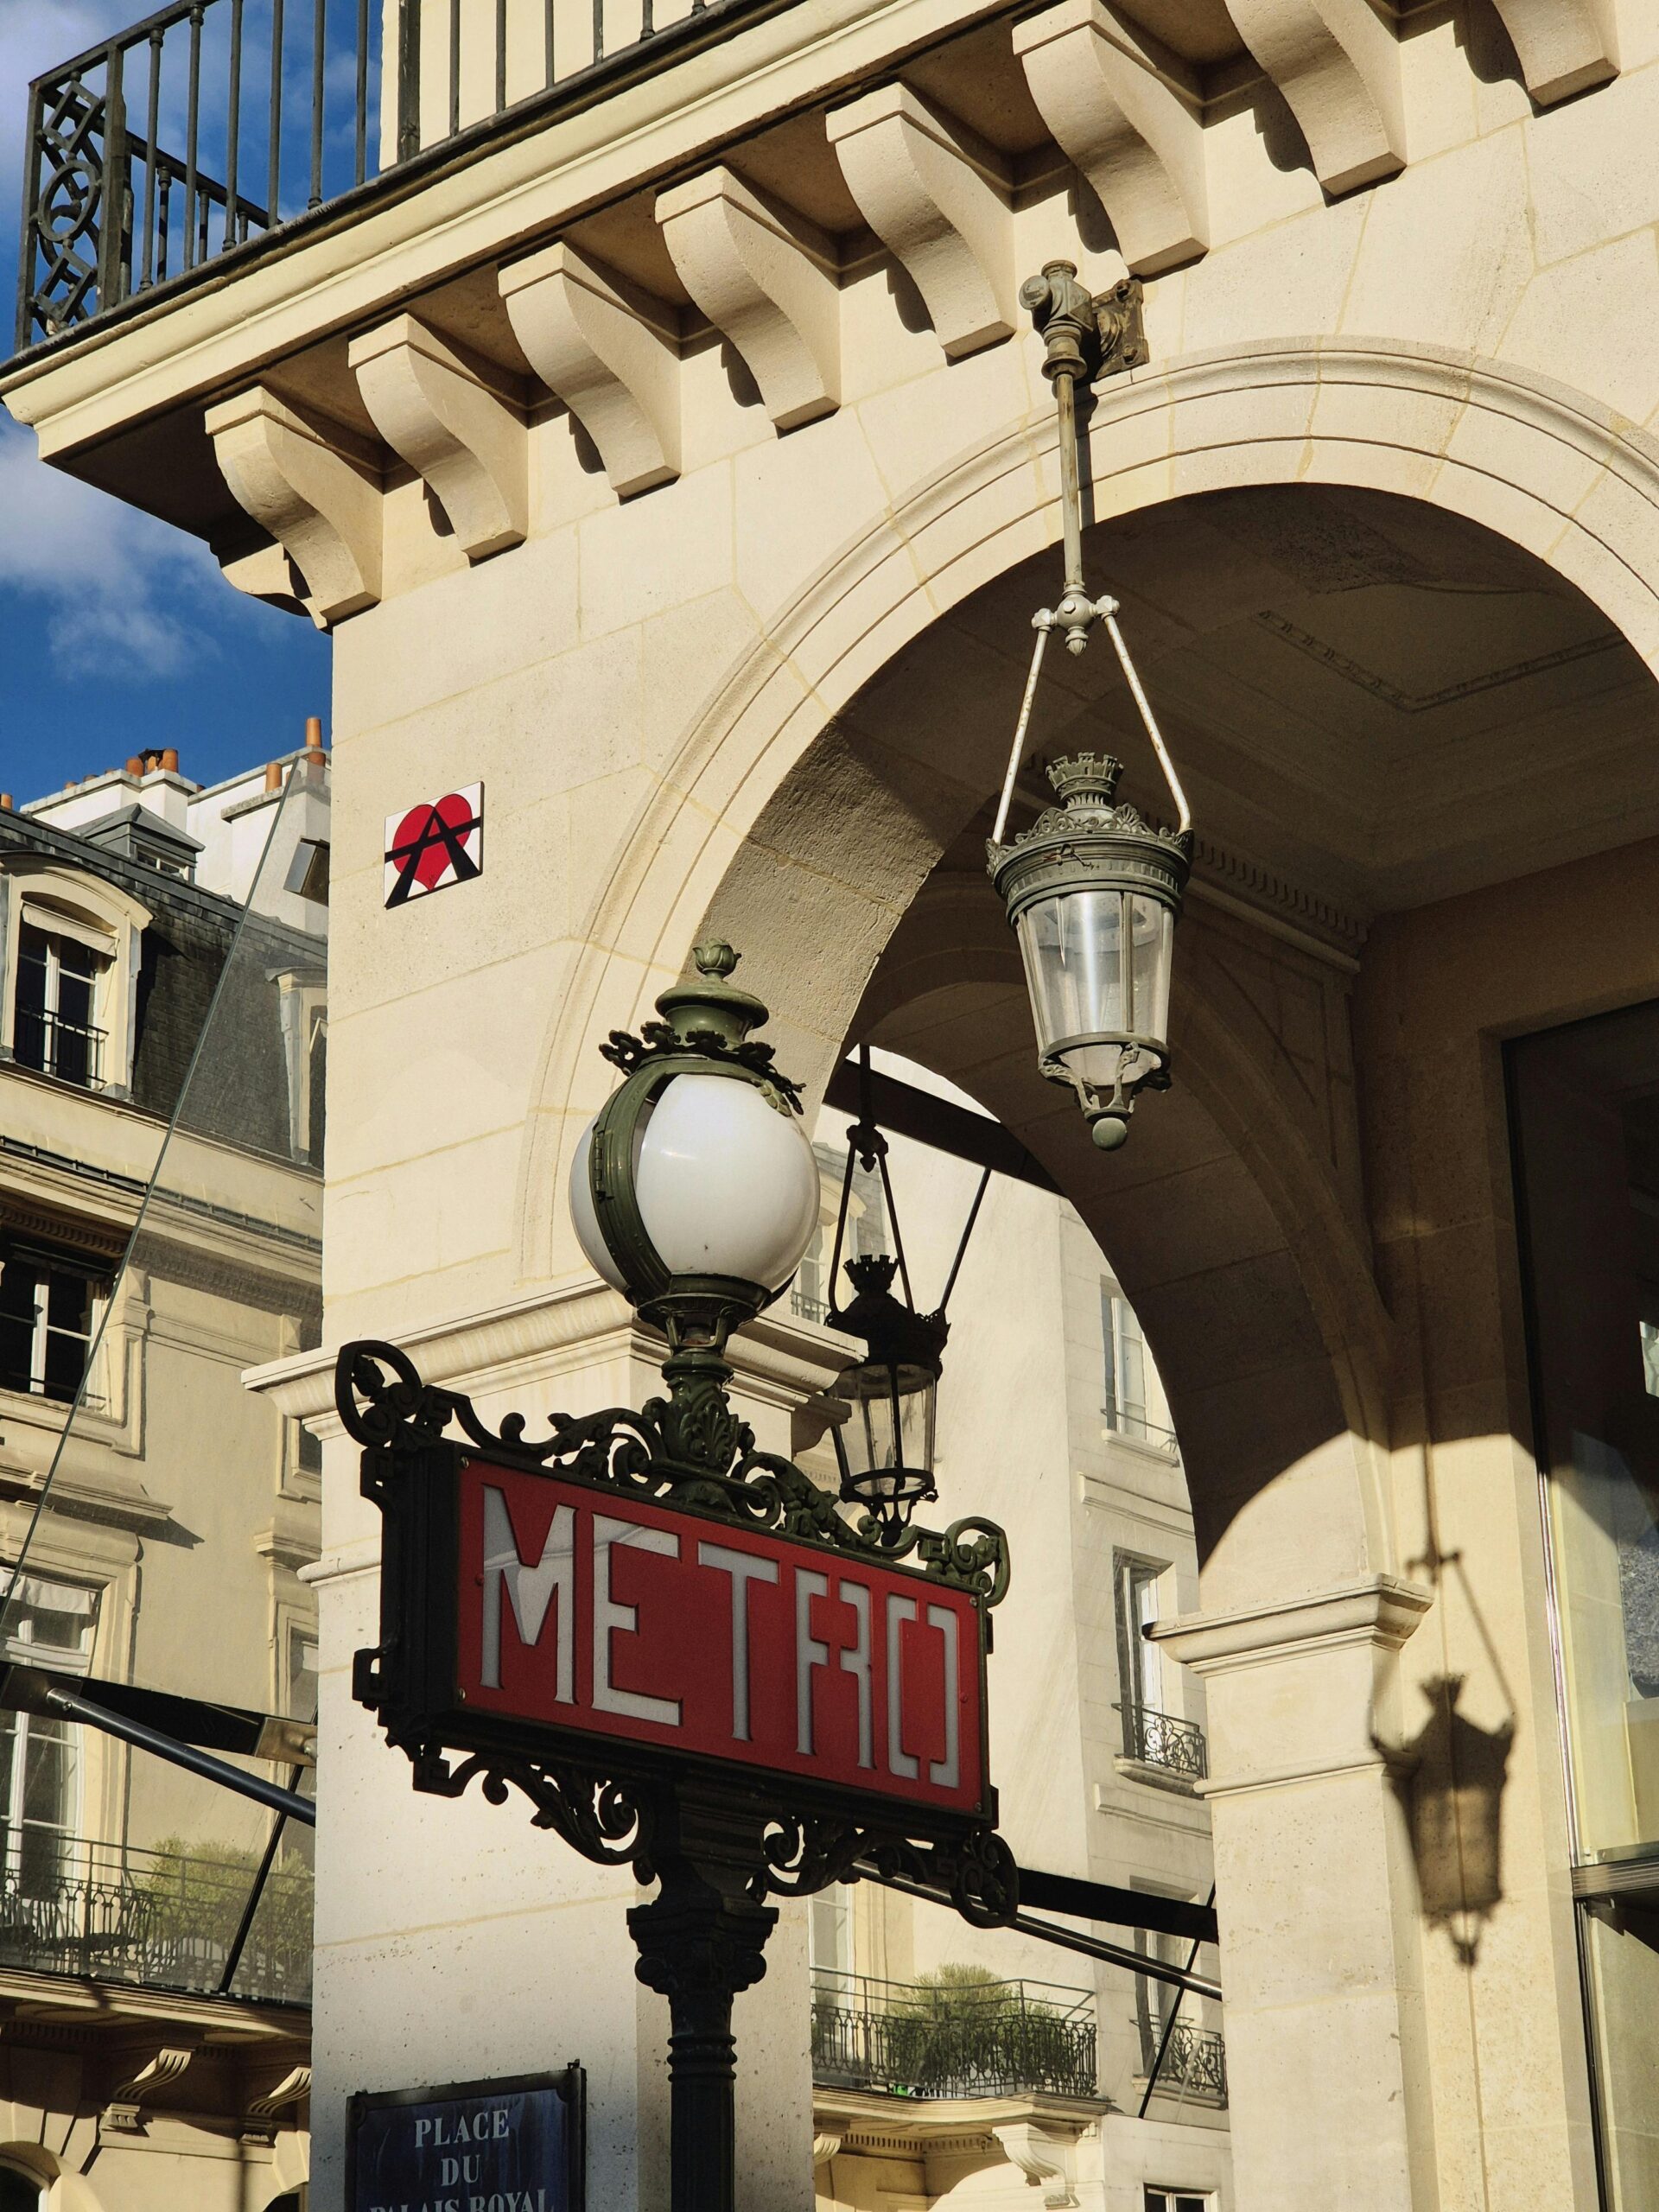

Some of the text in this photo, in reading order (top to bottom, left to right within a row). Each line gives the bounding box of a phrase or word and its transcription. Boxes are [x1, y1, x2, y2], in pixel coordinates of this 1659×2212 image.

[479, 1484, 960, 1789] METRO
[415, 2109, 509, 2147] PLACE
[441, 2154, 480, 2187] DU
